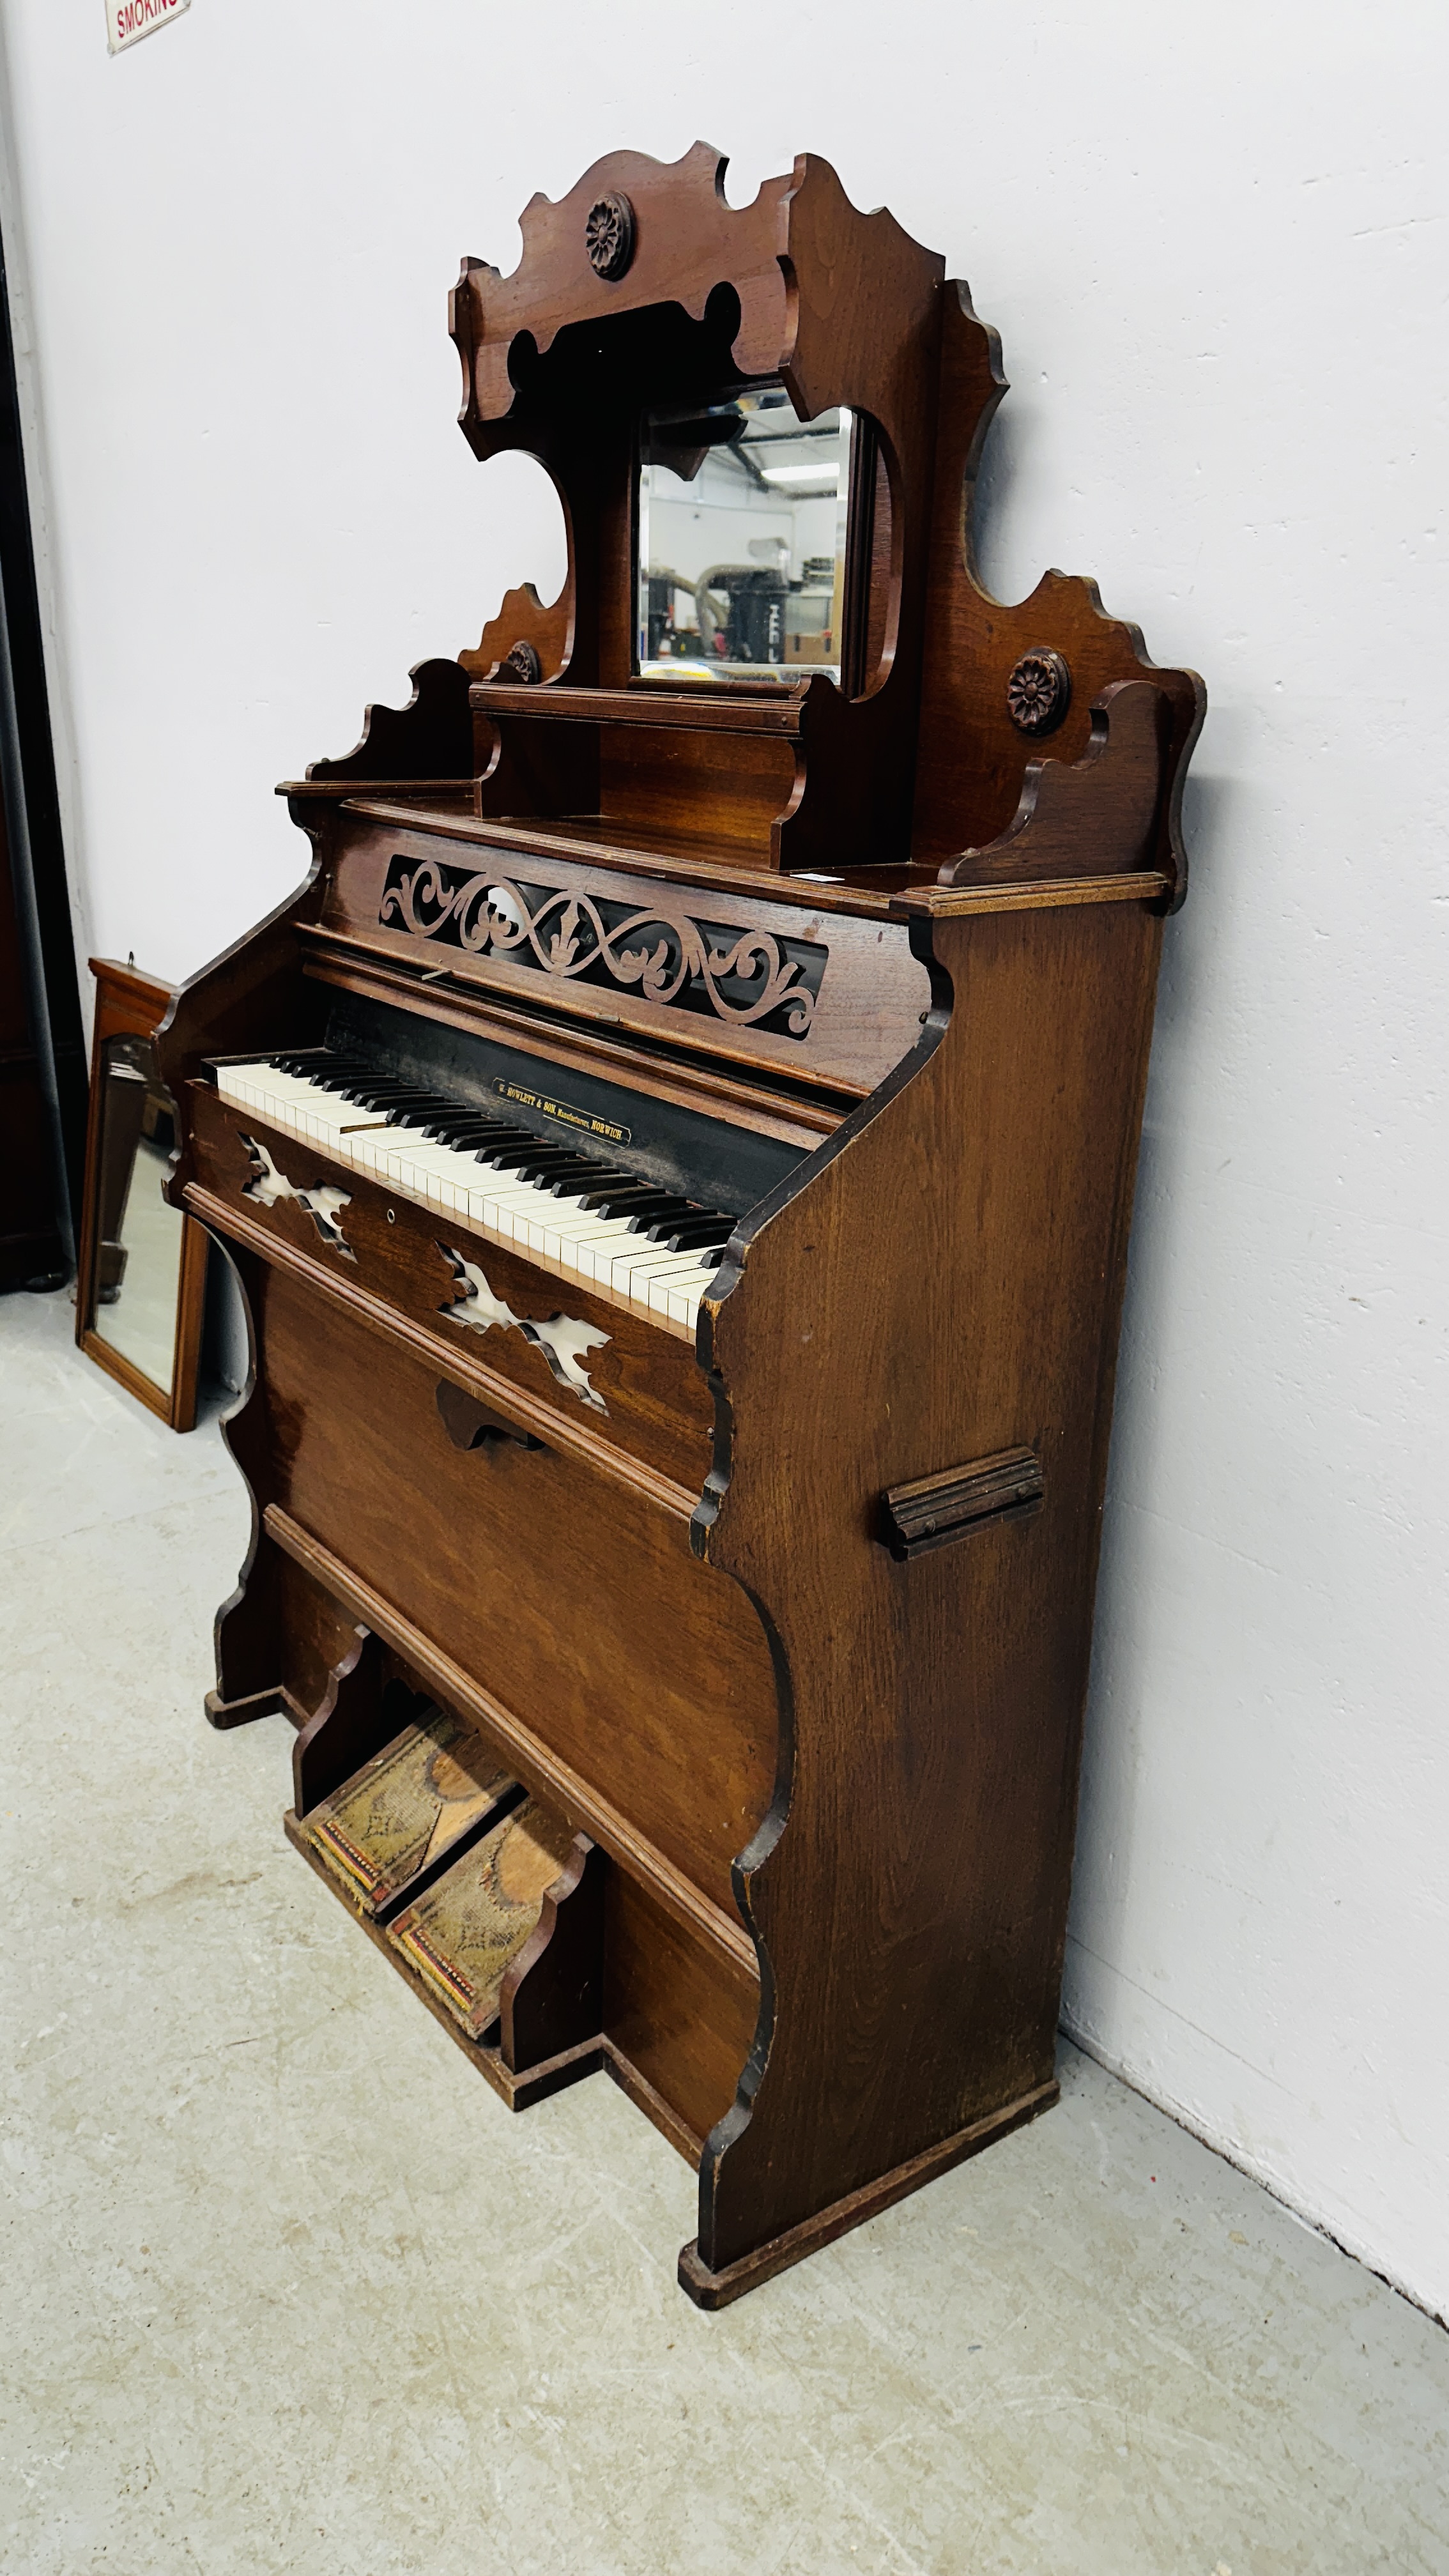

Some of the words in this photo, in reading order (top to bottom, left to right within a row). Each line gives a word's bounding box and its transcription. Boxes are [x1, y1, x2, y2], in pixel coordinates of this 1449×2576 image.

[118, 0, 178, 38] SMOKIN
[537, 1099, 542, 1108] &
[543, 1101, 556, 1115] SON,
[590, 1120, 623, 1140] NORWICH
